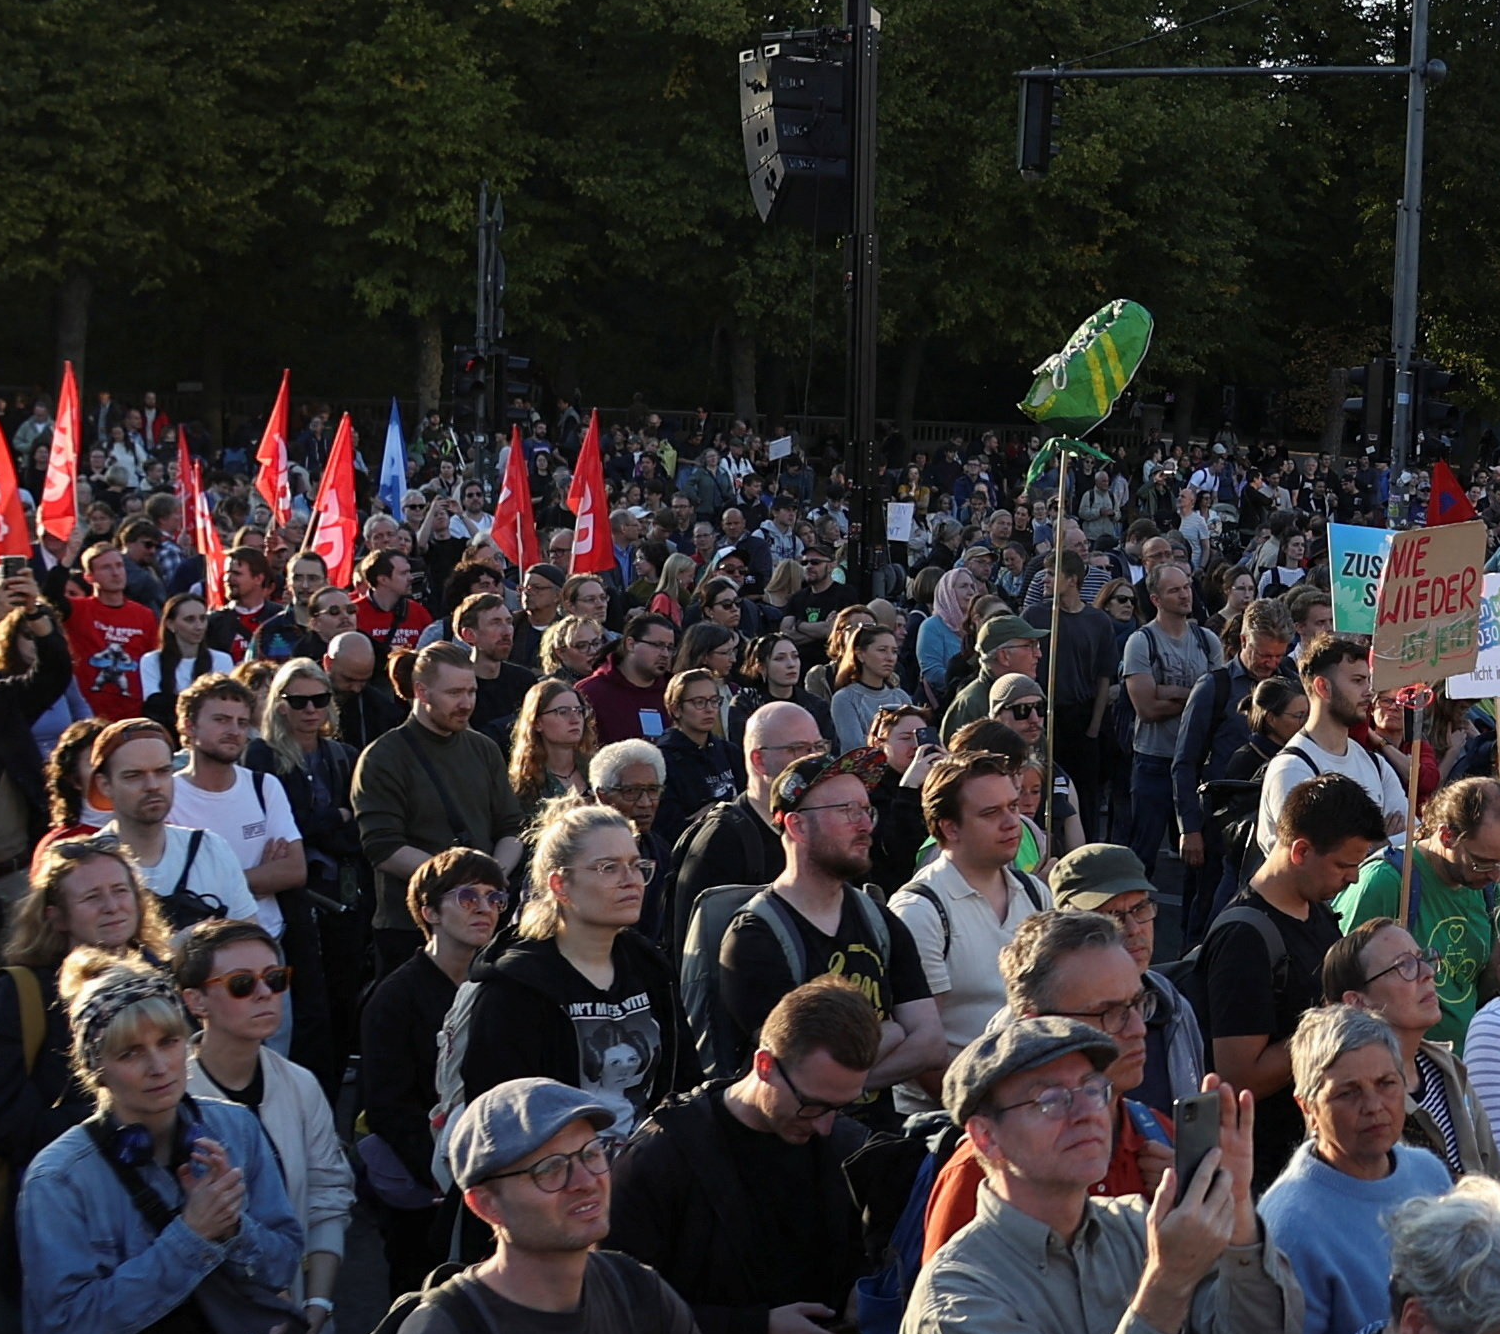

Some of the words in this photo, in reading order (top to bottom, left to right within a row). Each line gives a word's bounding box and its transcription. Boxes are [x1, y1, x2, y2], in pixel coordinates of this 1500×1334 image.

[1342, 552, 1382, 579] ZUS
[1385, 536, 1431, 583] NIE
[1380, 566, 1476, 628] WIEDER
[1400, 632, 1428, 663] IST
[1478, 629, 1500, 645] 030
